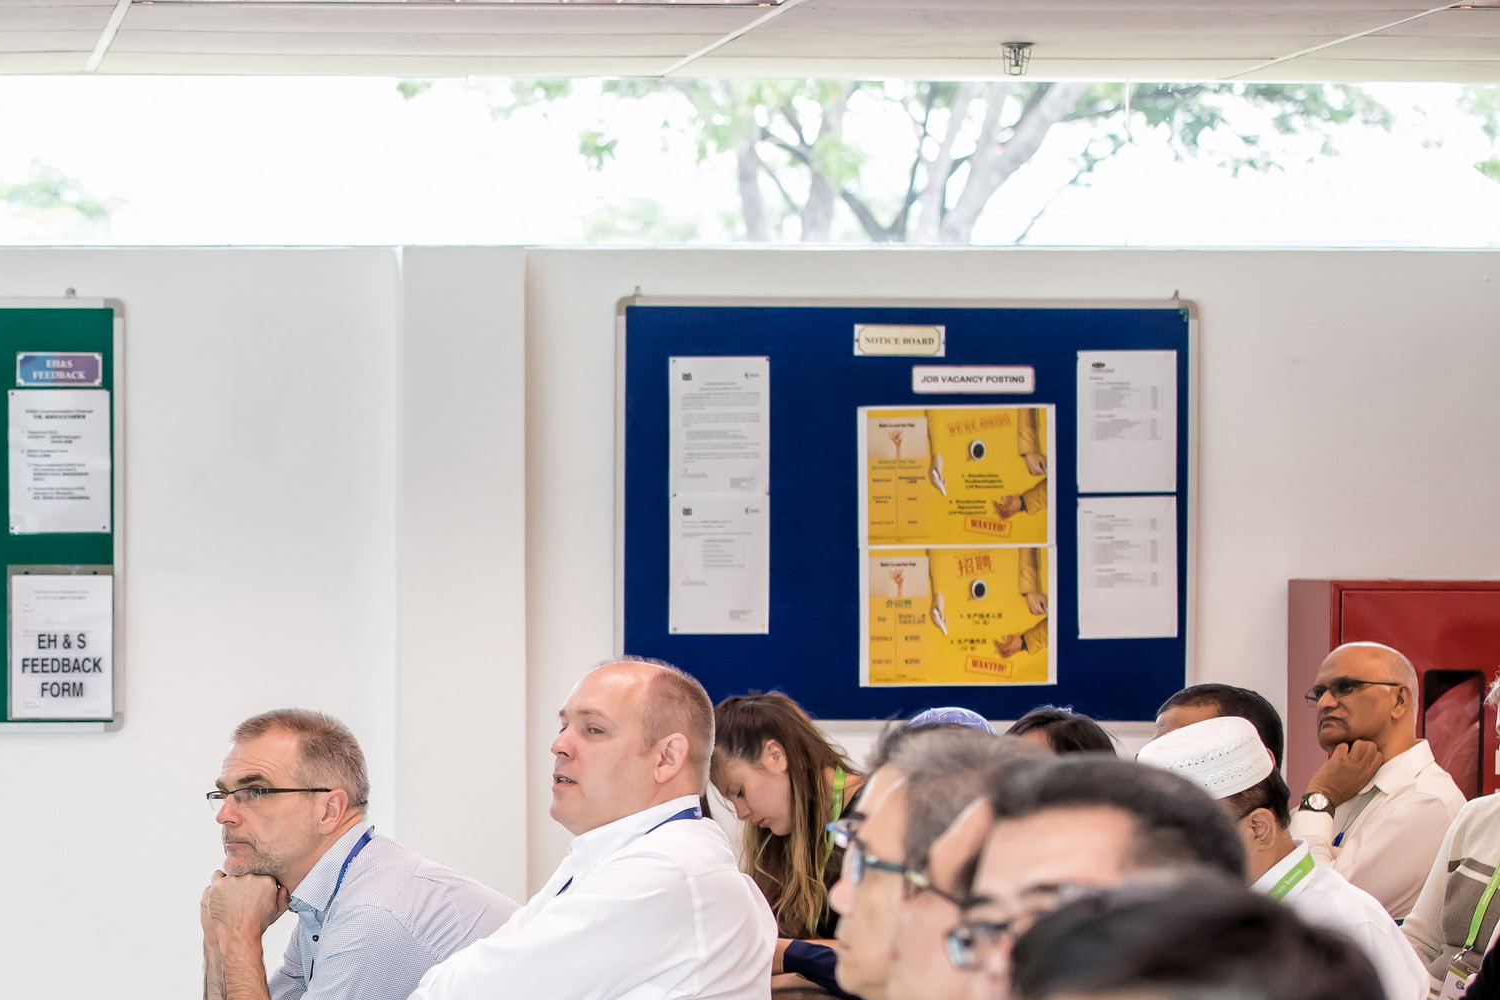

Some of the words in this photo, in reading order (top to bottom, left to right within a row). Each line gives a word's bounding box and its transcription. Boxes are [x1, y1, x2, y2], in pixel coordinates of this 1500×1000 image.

[864, 336, 900, 345] NOTICE
[902, 337, 935, 346] BOARD
[46, 360, 73, 368] EH&S
[32, 370, 86, 380] FEEDBACK
[920, 376, 940, 384] JOB
[942, 376, 984, 384] VACANCY
[986, 376, 1026, 384] POSTING
[948, 422, 975, 434] WE'RE
[970, 519, 1006, 532] WANTED!
[958, 554, 992, 576] 招聘
[38, 634, 57, 650] EH
[62, 634, 72, 650] &
[77, 633, 86, 650] S
[22, 658, 103, 674] FEEDBACK
[972, 659, 1007, 672] WANTED!
[41, 682, 84, 698] FORM
